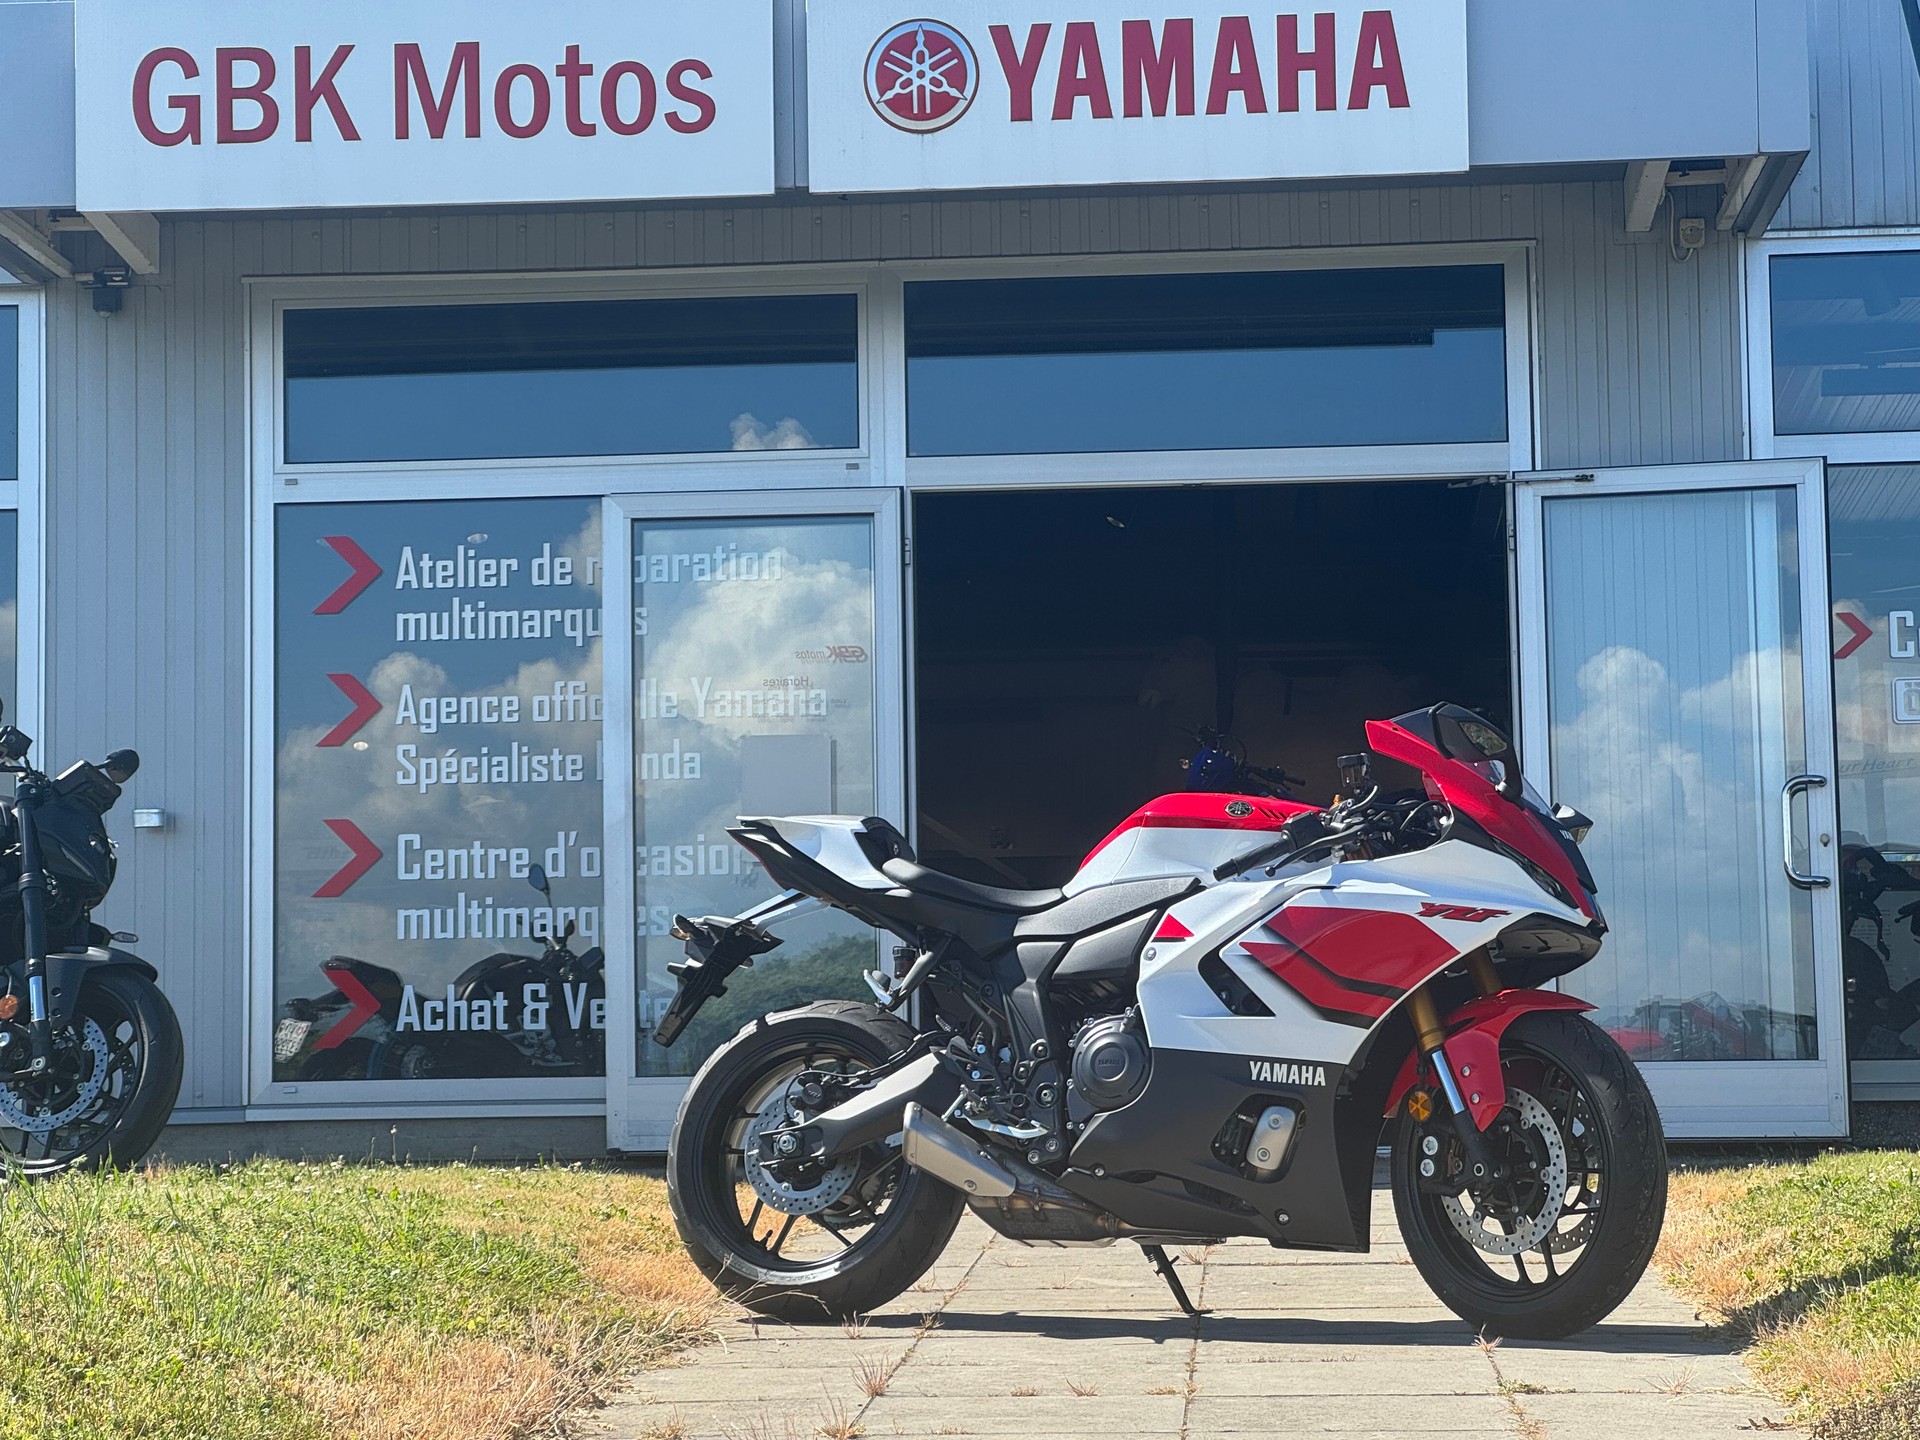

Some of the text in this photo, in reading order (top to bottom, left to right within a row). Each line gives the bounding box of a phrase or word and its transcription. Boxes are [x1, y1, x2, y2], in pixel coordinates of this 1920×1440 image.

[988, 10, 1410, 122] YAMAHA
[132, 42, 717, 147] GBK Motos
[395, 542, 782, 589] Atelier de raration
[396, 597, 648, 647] multimarqus
[1889, 611, 1920, 658] C
[395, 676, 827, 734] Agence officlle Yamaha
[396, 738, 700, 794] Spécialiste nda
[397, 833, 530, 880] Centre
[397, 892, 669, 948] multimarqs
[396, 983, 672, 1031] Achat & Vete
[1249, 1061, 1326, 1087] YAMAHA
